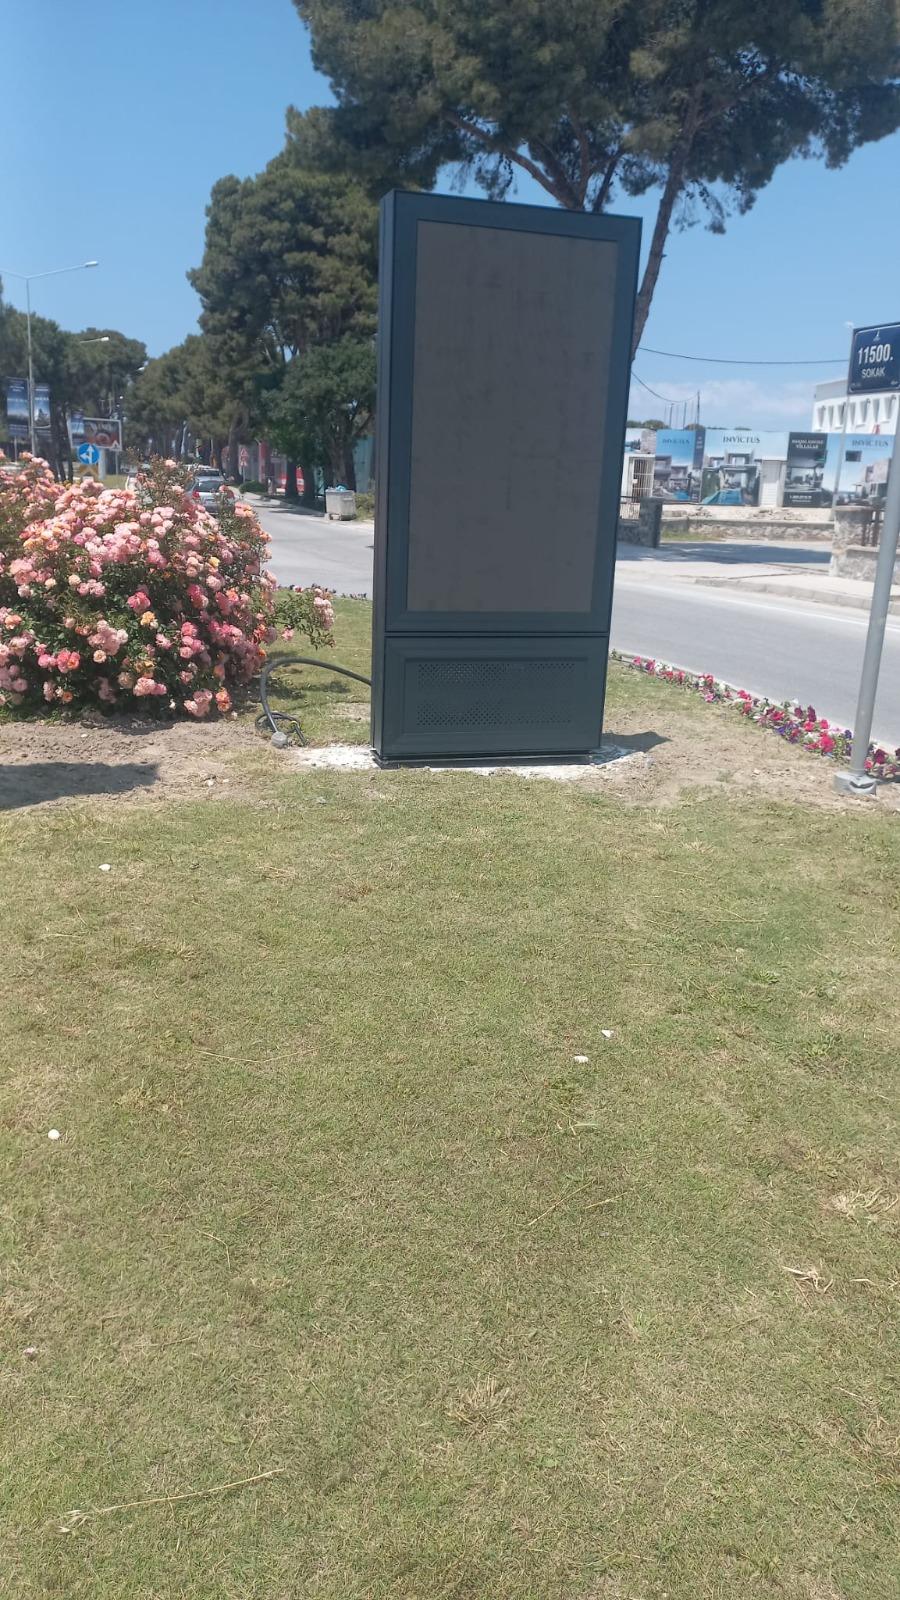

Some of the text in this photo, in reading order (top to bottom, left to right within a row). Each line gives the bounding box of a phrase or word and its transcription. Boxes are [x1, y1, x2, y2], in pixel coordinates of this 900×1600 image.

[858, 344, 894, 365] 11500.
[861, 367, 886, 378] SOKAK
[723, 435, 760, 443] INVICTUS
[852, 439, 889, 447] INVICTUS
